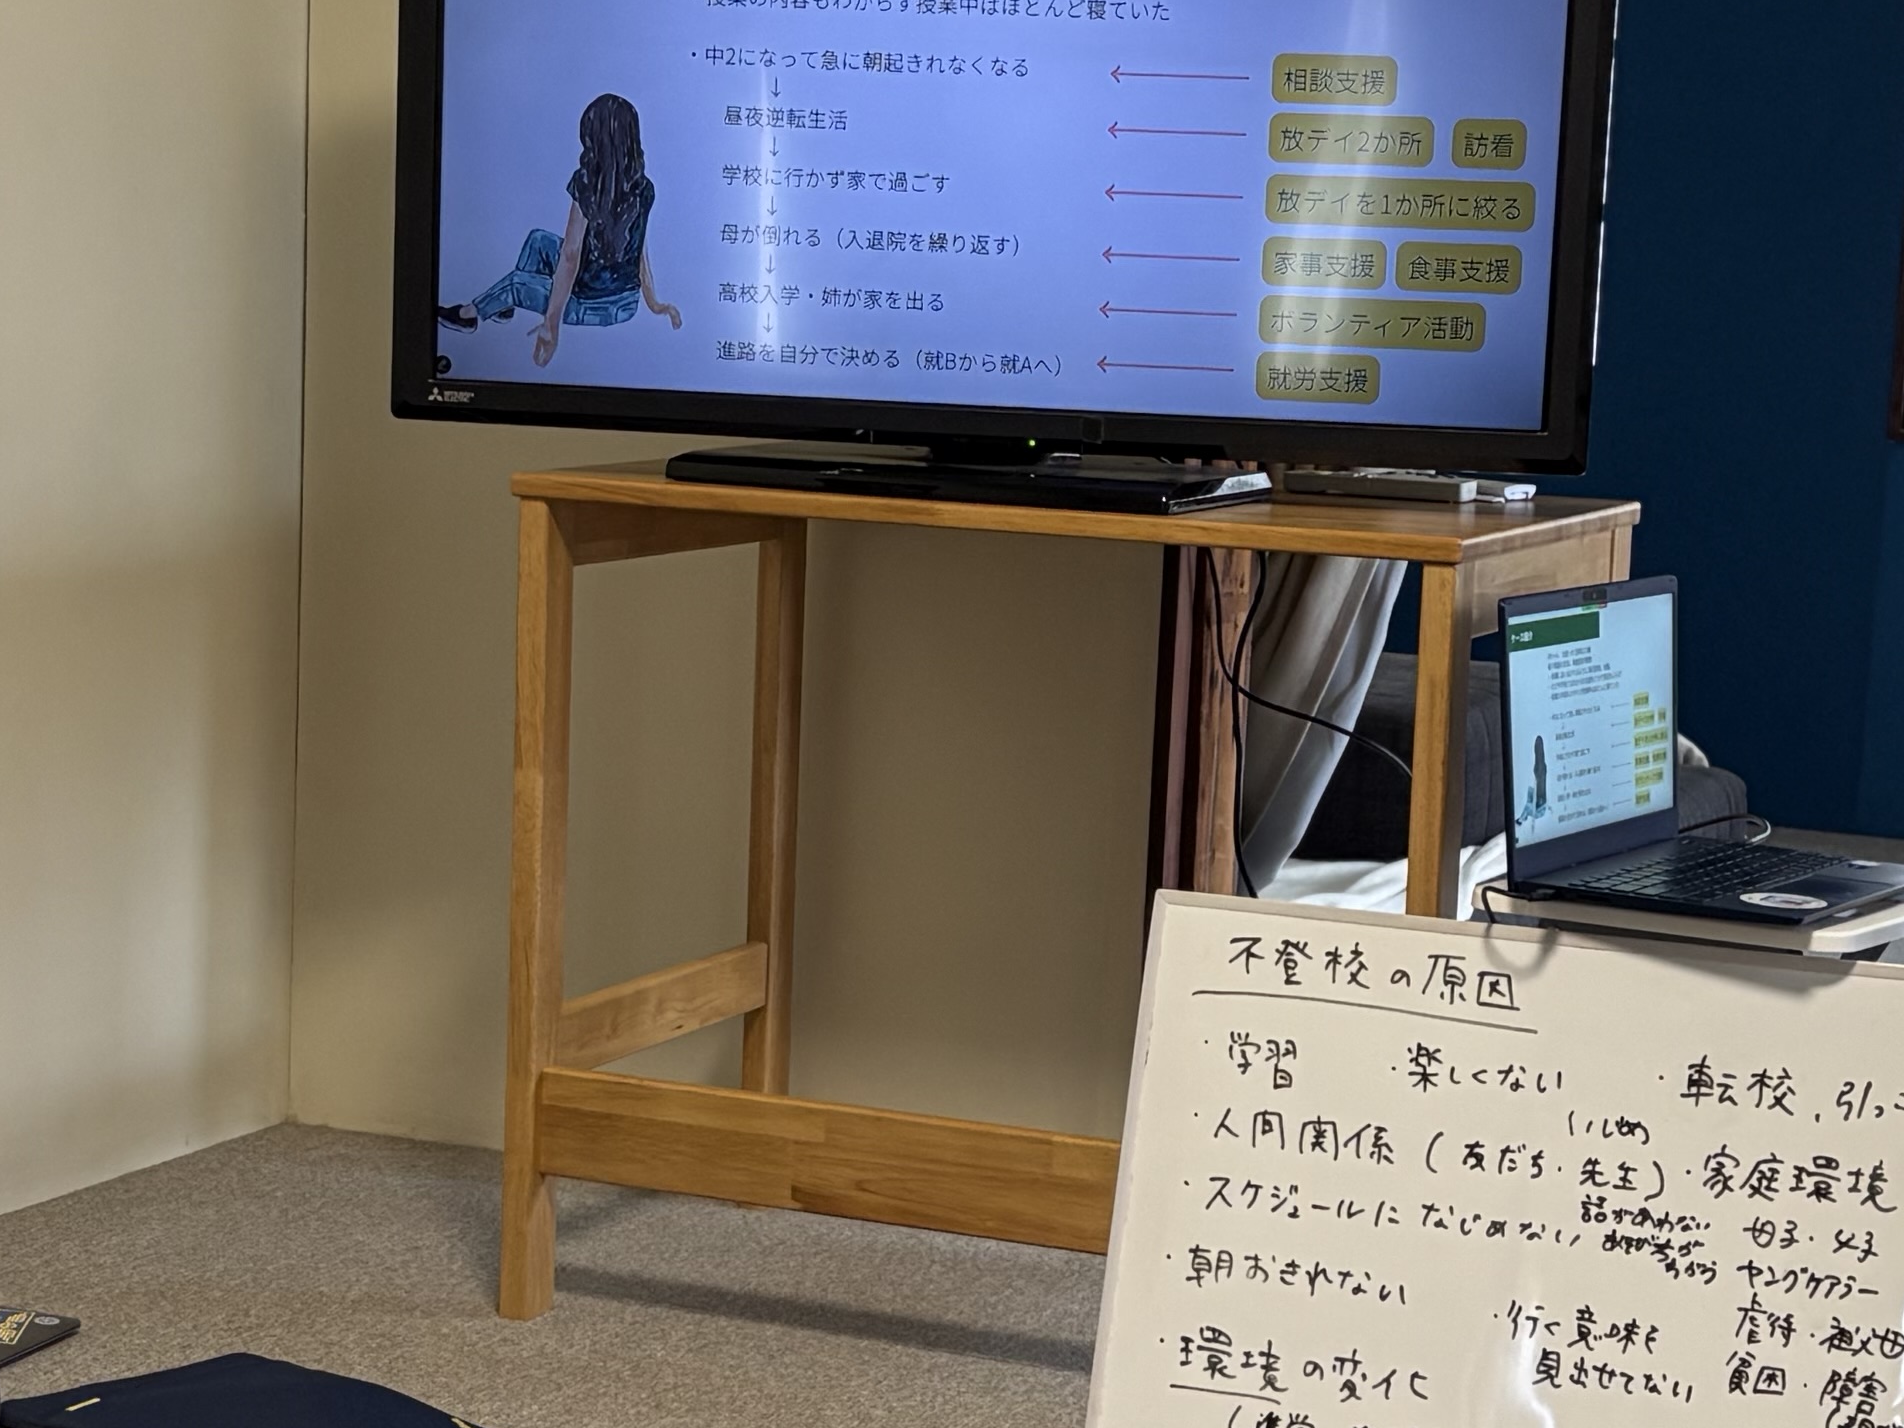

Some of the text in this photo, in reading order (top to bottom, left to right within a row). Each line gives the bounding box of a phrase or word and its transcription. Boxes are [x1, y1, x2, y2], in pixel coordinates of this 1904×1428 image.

[1282, 67, 1387, 97] 相談支援
[722, 105, 849, 133] 昼夜逆転生活
[1279, 125, 1424, 158] 放デイ2か所
[1463, 132, 1515, 160] 訪看
[720, 163, 951, 196] 学校に行かず家で過ごす
[1276, 187, 1524, 223] 放デイを1か所に絞る
[718, 223, 1022, 259] 母が倒れる（入退院を繰り返す）
[1272, 251, 1377, 280] 家事支援
[1408, 257, 1512, 285] 食事支援
[716, 281, 946, 314] 高校入学・姉が家を出る
[1269, 309, 1476, 343] ボランティア活動
[715, 338, 1065, 379] 進路を自分で決める（就Bから就Aへ）
[1267, 366, 1370, 395] 就労支援
[1228, 936, 1521, 1012] 不登校の原因
[1742, 1215, 1880, 1264] 母子・父子
[1736, 1259, 1880, 1301] ヤングケアラー
